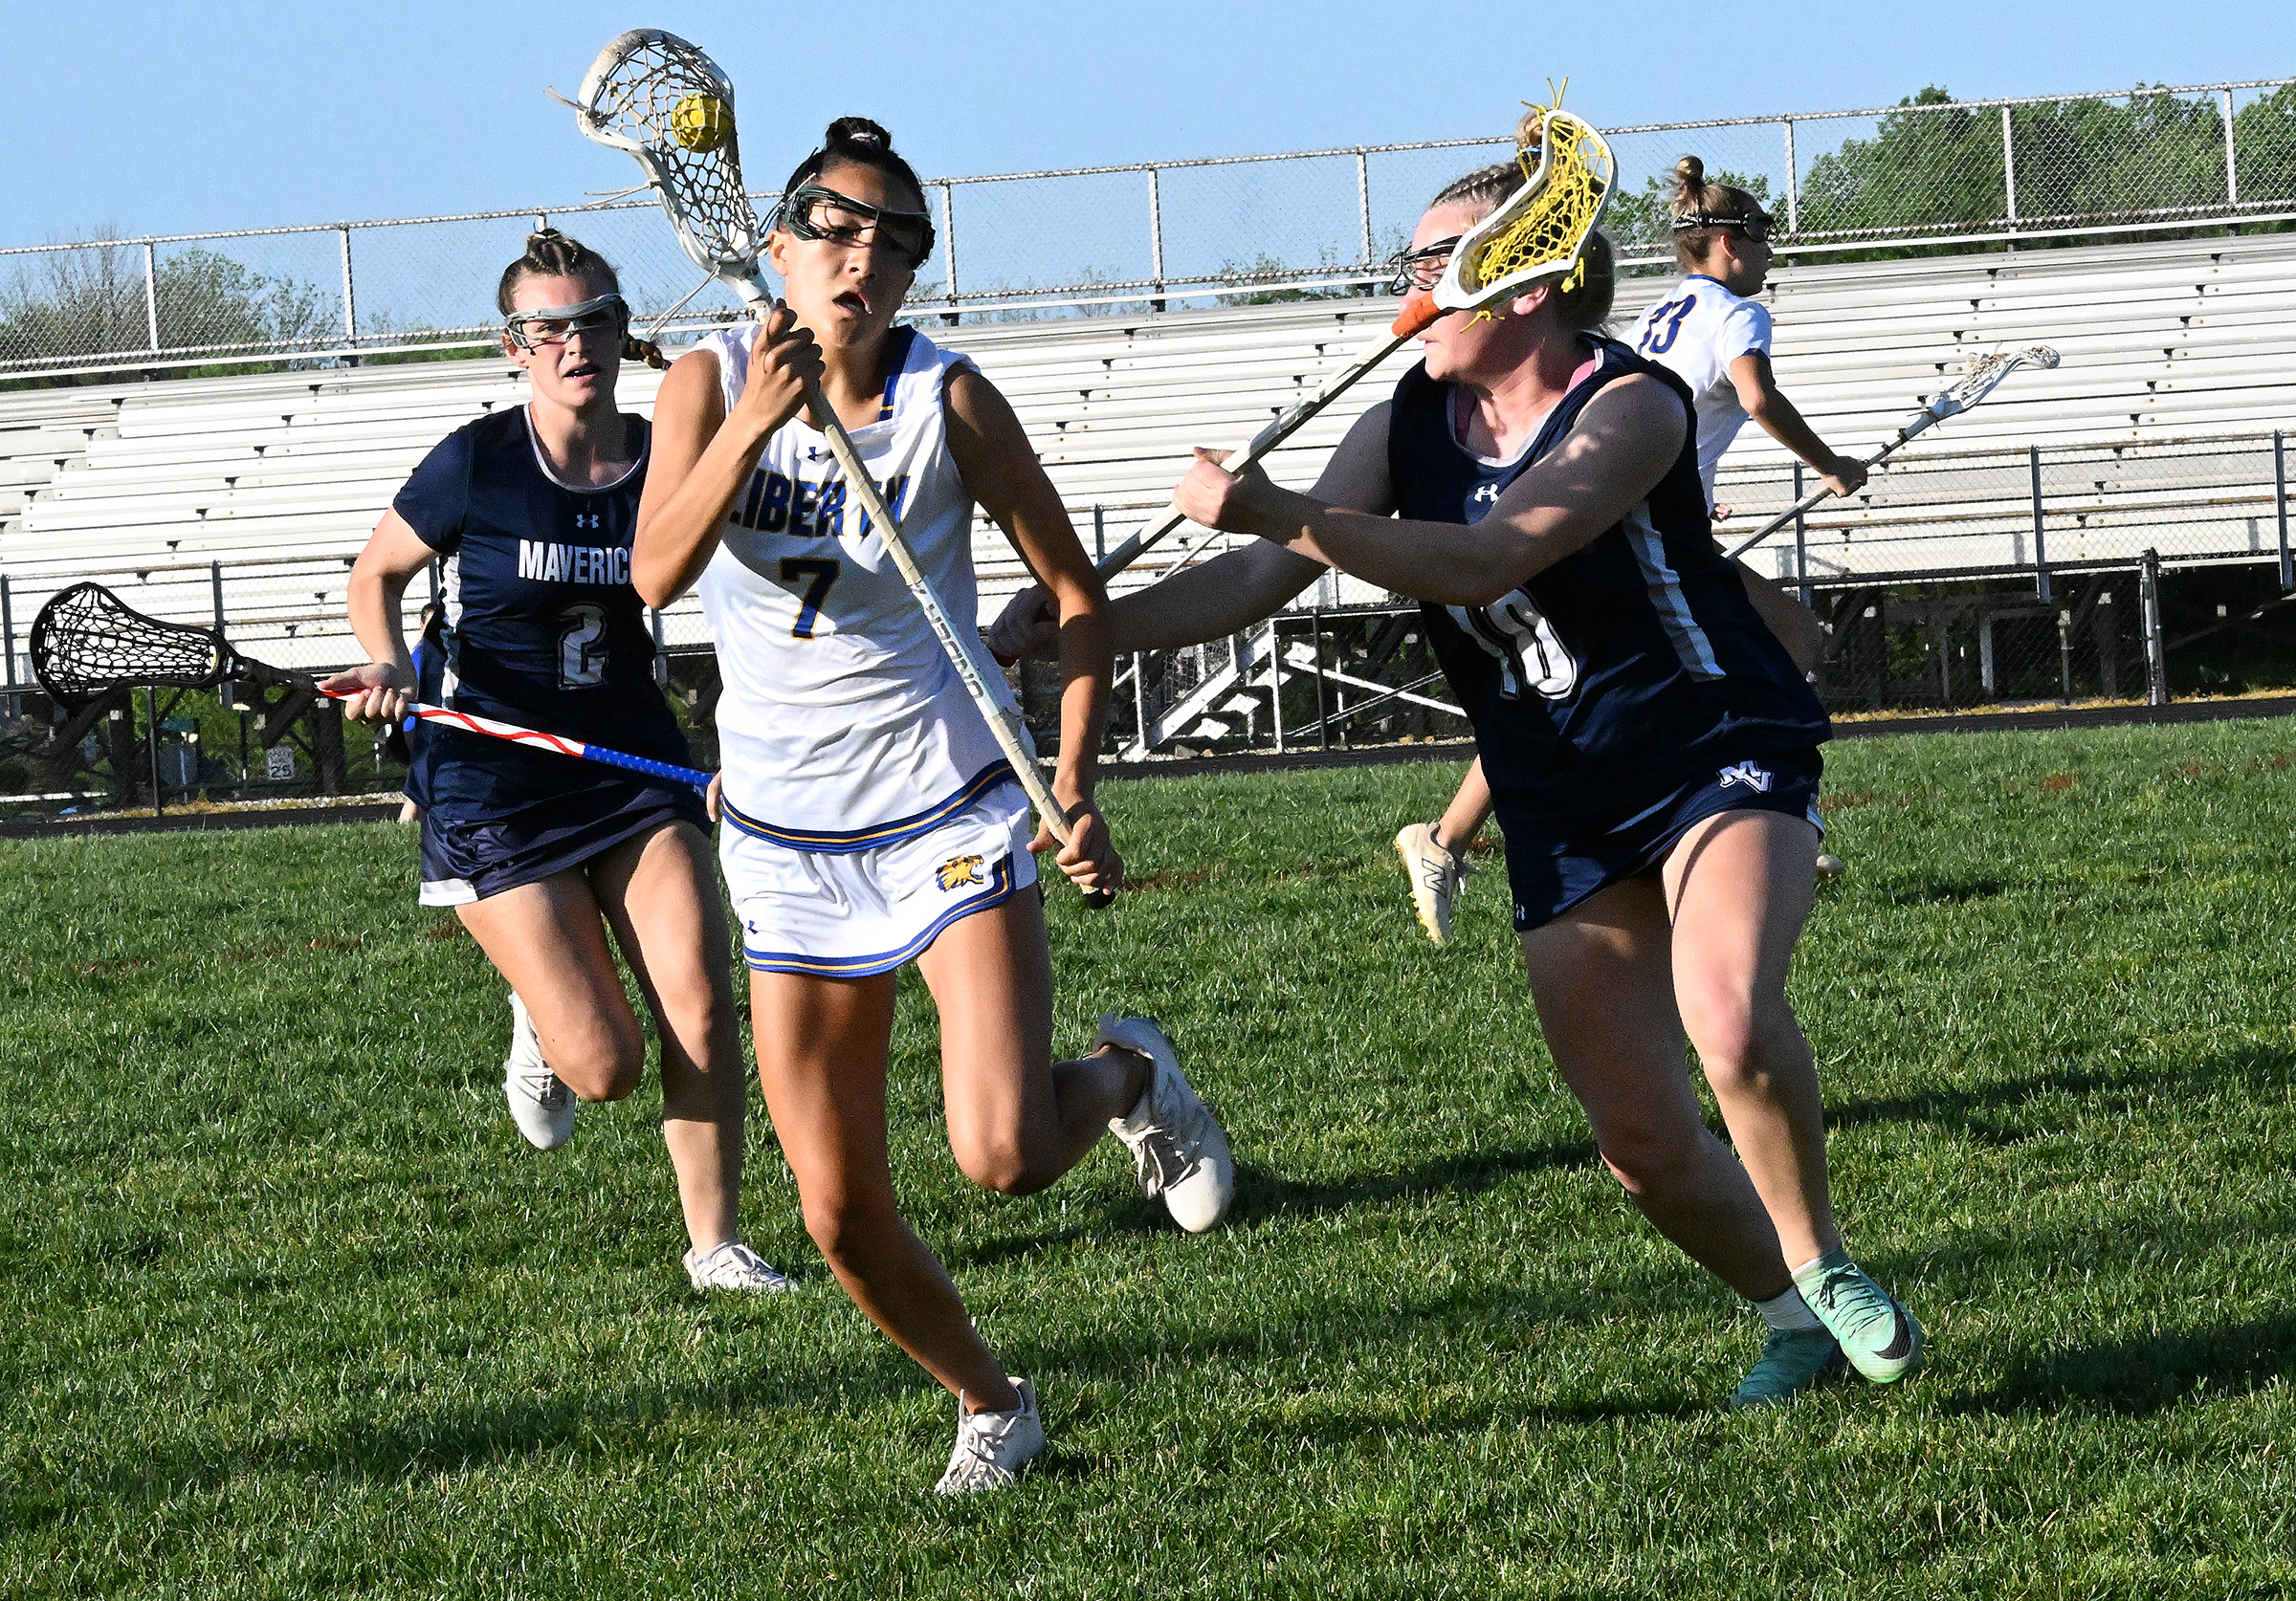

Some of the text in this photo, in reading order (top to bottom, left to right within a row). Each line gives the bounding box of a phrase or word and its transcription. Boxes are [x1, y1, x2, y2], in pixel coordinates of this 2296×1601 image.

[1638, 293, 1698, 356] 13
[729, 468, 912, 538] IBERY
[518, 538, 636, 585] MAVERIC
[779, 557, 840, 641] 7
[557, 601, 610, 691] 2
